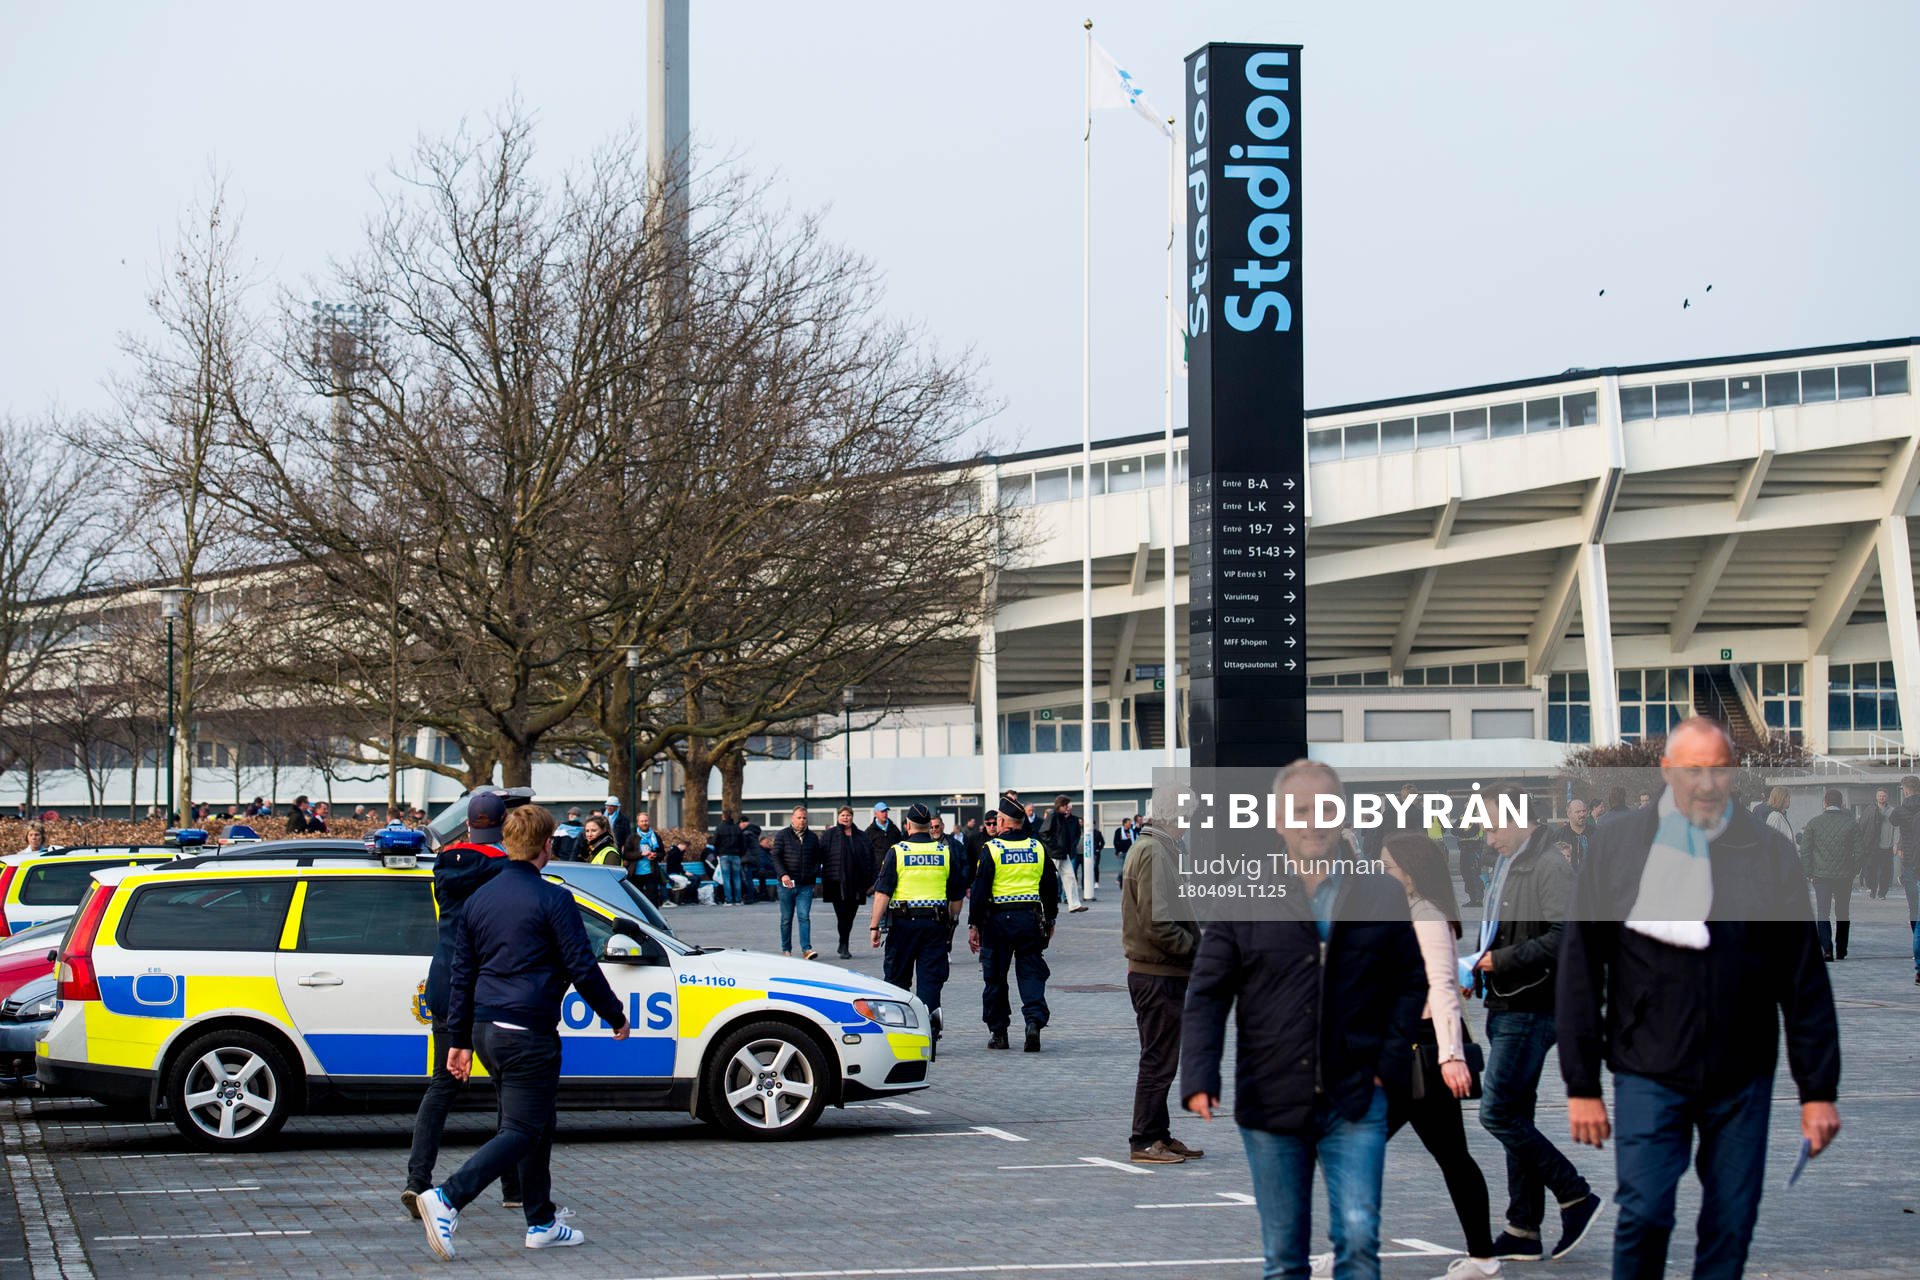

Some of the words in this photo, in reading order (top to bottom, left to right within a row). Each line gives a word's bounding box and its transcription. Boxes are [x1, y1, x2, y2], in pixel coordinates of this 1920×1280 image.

[1188, 53, 1208, 338] Stadion
[1224, 52, 1292, 332] Stadion
[1248, 478, 1269, 489] B-A
[1248, 501, 1267, 512] L-K
[1249, 523, 1273, 535] 19-7
[1248, 546, 1280, 557] 51-43
[1223, 570, 1236, 578] VIP
[1223, 592, 1259, 602] Varuintag
[1223, 638, 1239, 646] MFF
[1240, 637, 1268, 647] Shopen
[1223, 661, 1278, 670] Uttagsautomat
[909, 855, 940, 865] POLIS
[1005, 852, 1035, 864] POLIS
[679, 973, 736, 987] 64-1160
